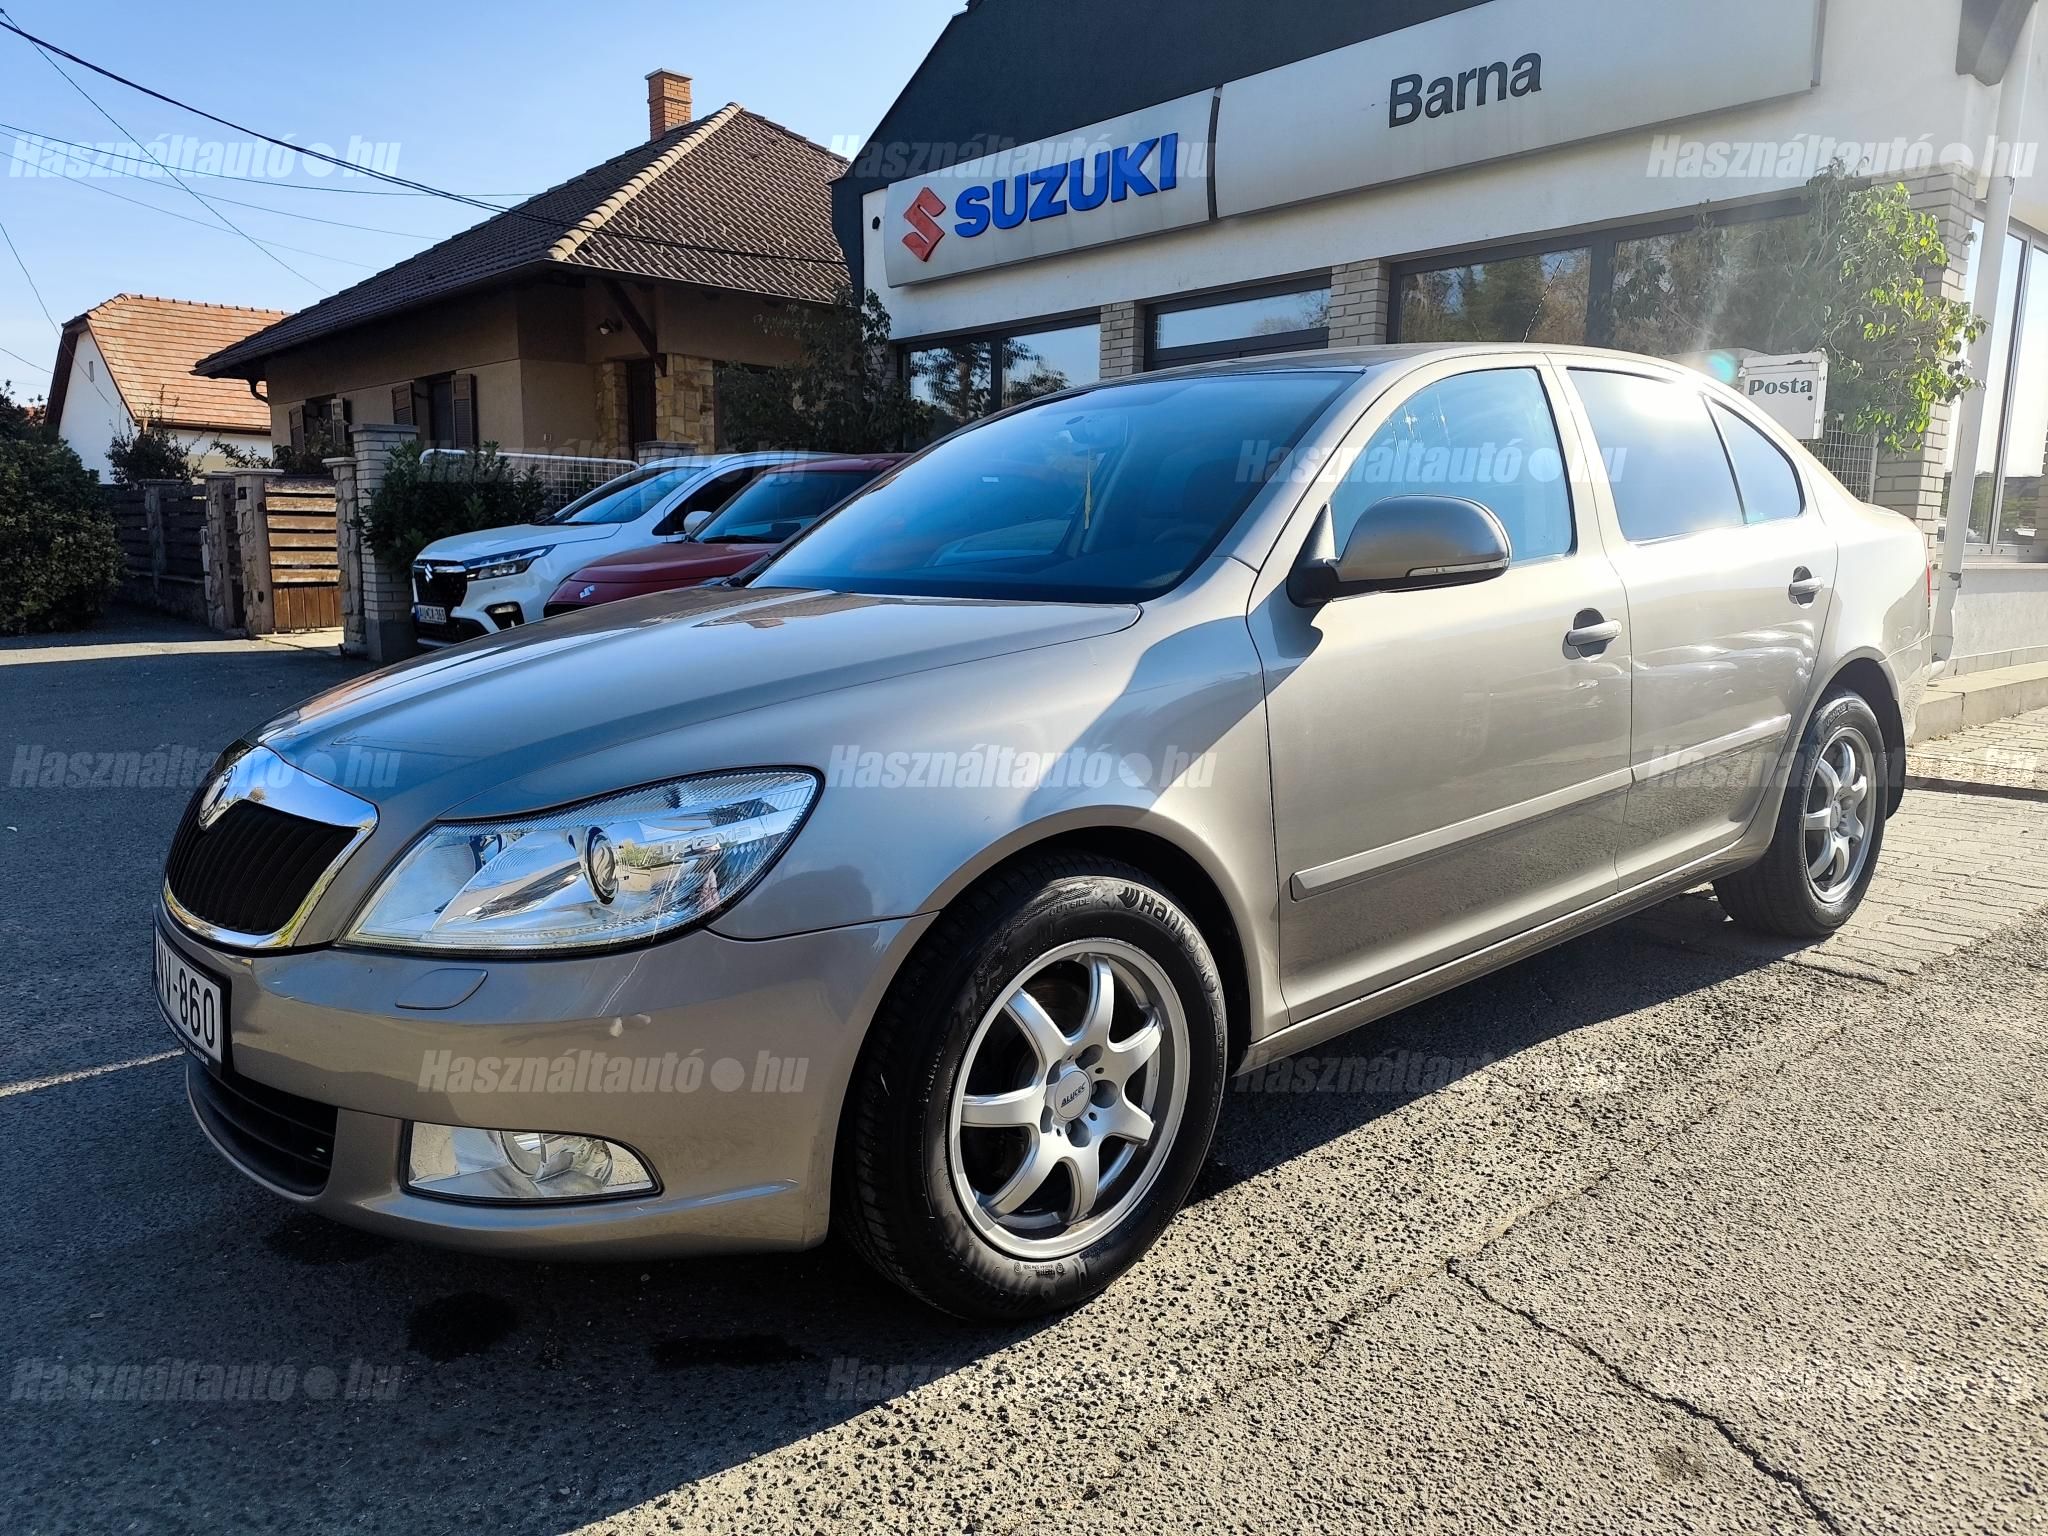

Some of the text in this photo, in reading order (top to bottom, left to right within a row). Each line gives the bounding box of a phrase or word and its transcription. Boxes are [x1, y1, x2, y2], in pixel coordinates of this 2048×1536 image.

[1389, 53, 1542, 128] Barna
[954, 132, 1178, 238] SUZUKI
[1749, 377, 1813, 395] Posta
